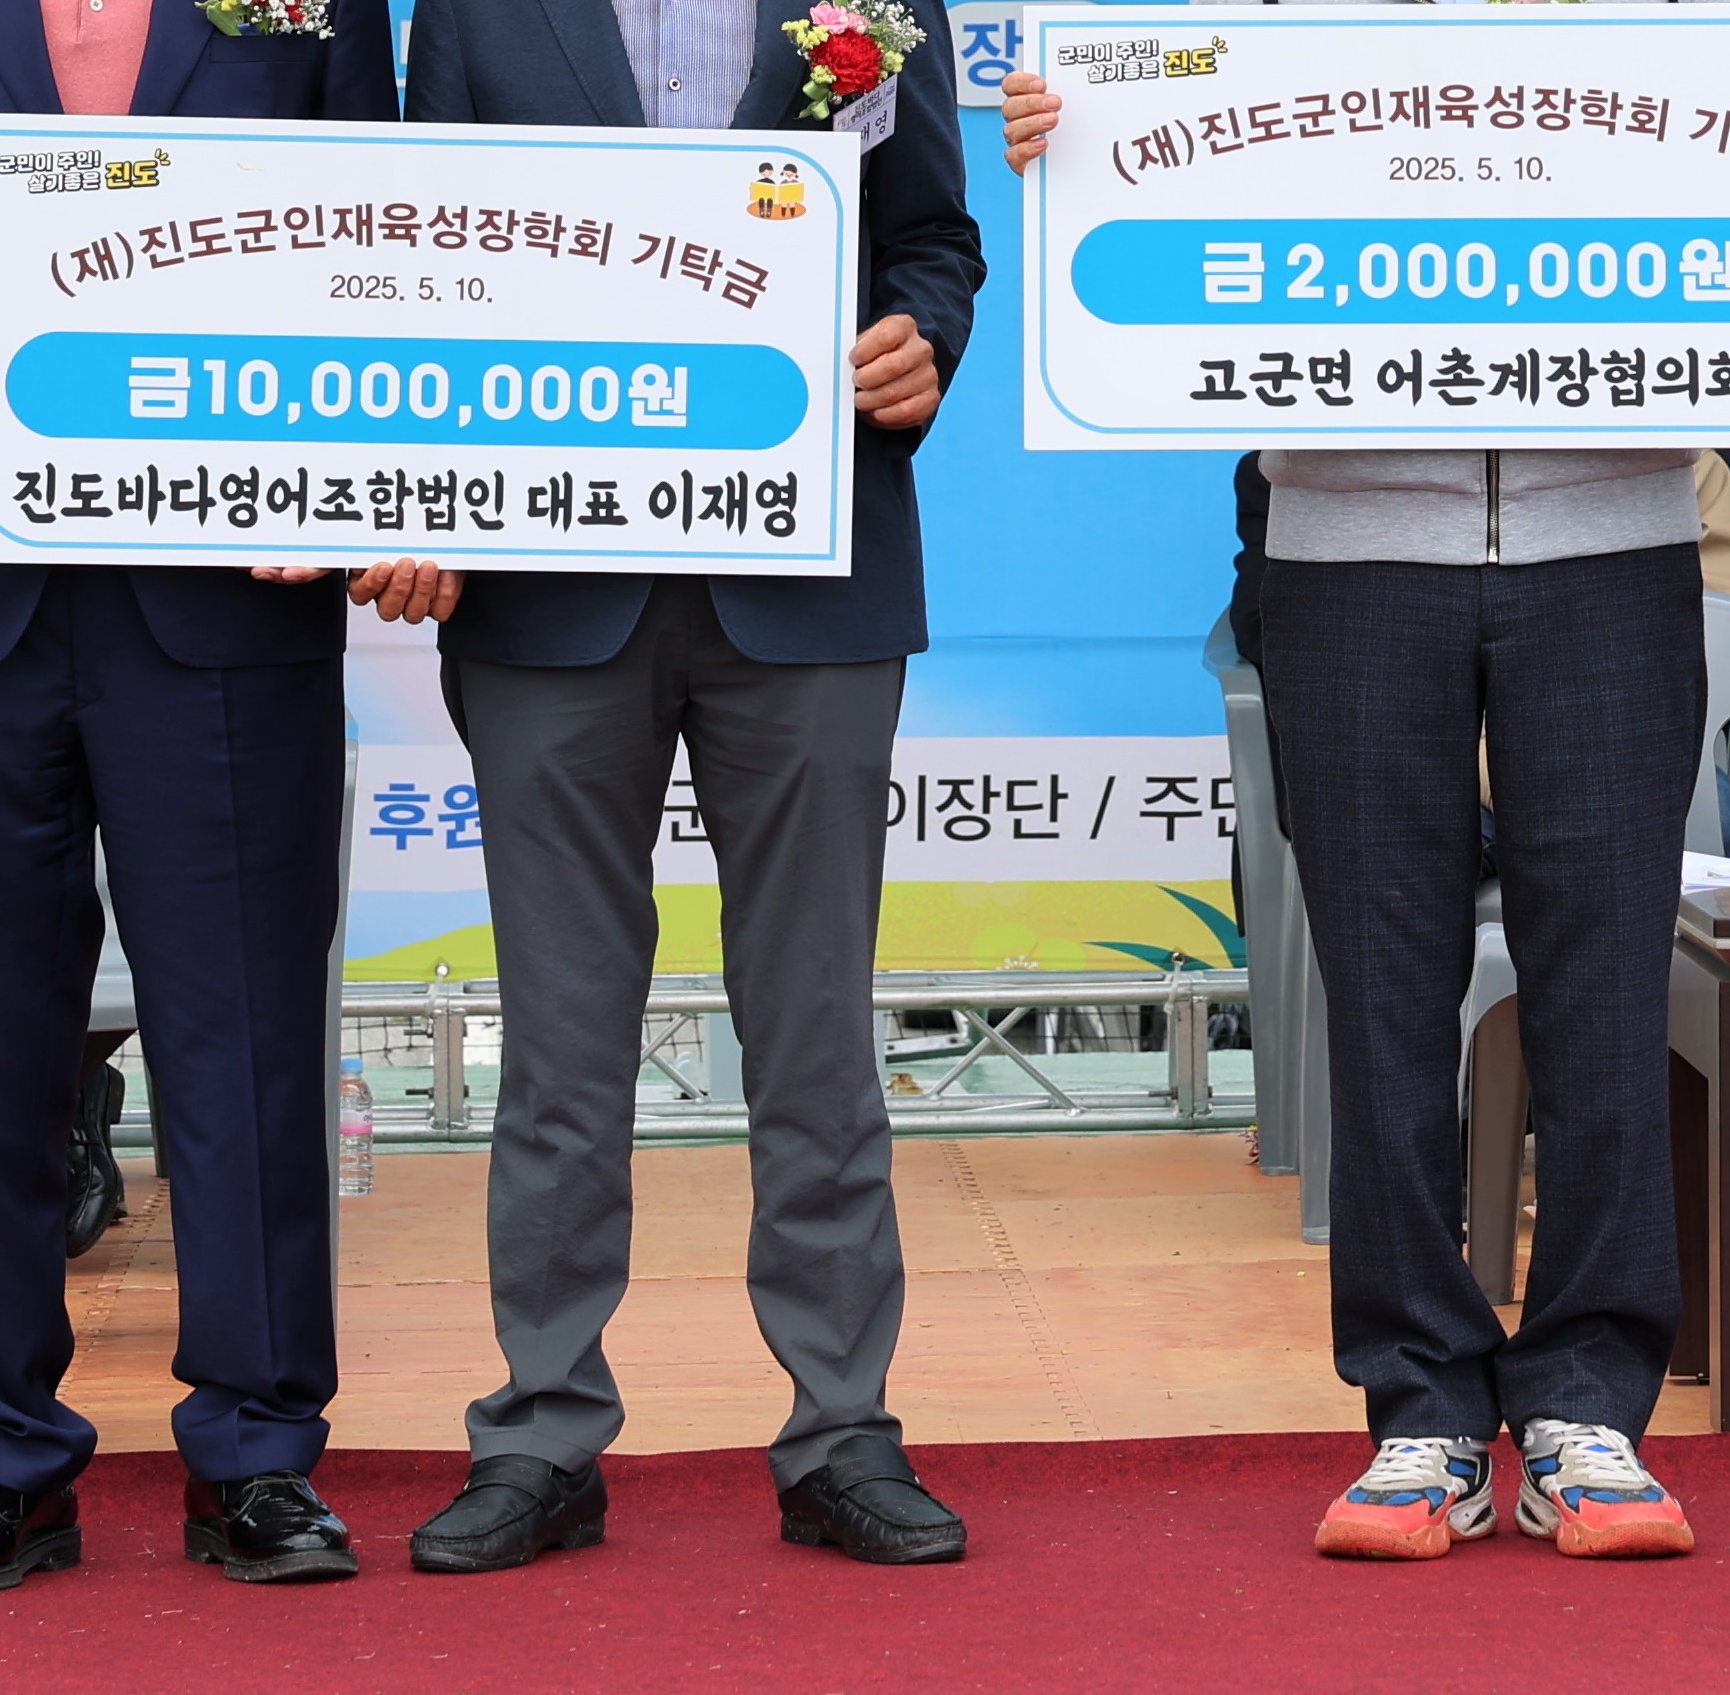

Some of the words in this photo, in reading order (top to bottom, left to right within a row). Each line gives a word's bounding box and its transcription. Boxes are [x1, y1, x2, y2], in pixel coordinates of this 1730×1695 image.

[1057, 43, 1112, 65] 군민이
[1116, 39, 1159, 60] 주인!
[1087, 60, 1159, 84] 살기좋은
[1163, 48, 1217, 77] 진도
[861, 109, 887, 144] 재영
[1112, 84, 1670, 186] (재)진도군인재육성장학회
[28, 171, 101, 194] 살기좋은
[105, 160, 159, 190] 진도
[57, 150, 101, 170] 주인!
[1389, 156, 1464, 182] 2025.
[1477, 157, 1501, 182] 5.
[1514, 156, 1551, 182] 10.
[51, 203, 613, 298] (재)진도군인재육성장학회
[631, 233, 769, 310] 기탁금
[1202, 242, 1265, 303] 금
[330, 274, 405, 301] 2025.
[418, 277, 442, 302] 5.
[455, 277, 493, 303] 10.
[128, 356, 688, 428] 금10,000,000원
[1189, 348, 1354, 407] 고군면
[12, 462, 505, 532] 진도바다영어조합법인
[527, 471, 629, 533] 대표
[648, 469, 798, 538] 이재영
[369, 782, 484, 850] 후원
[887, 773, 1069, 843] 이장단
[1089, 775, 1117, 841] /
